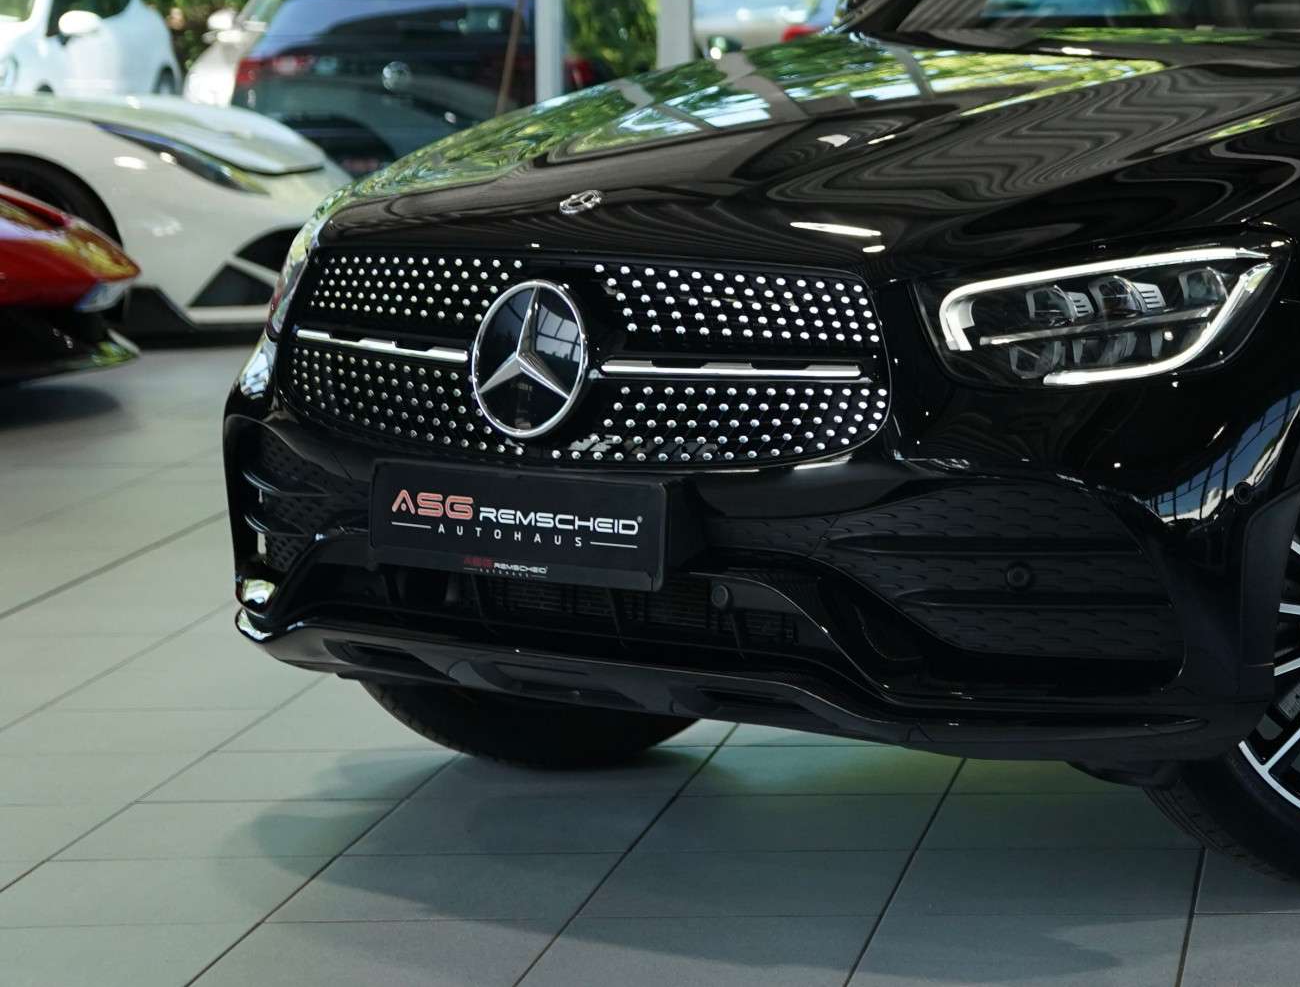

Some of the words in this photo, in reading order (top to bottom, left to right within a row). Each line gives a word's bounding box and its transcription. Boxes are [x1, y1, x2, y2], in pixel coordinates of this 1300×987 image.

[391, 489, 474, 520] ASG
[479, 507, 639, 535] REMSCHEID
[438, 523, 582, 547] AUTOHAUS
